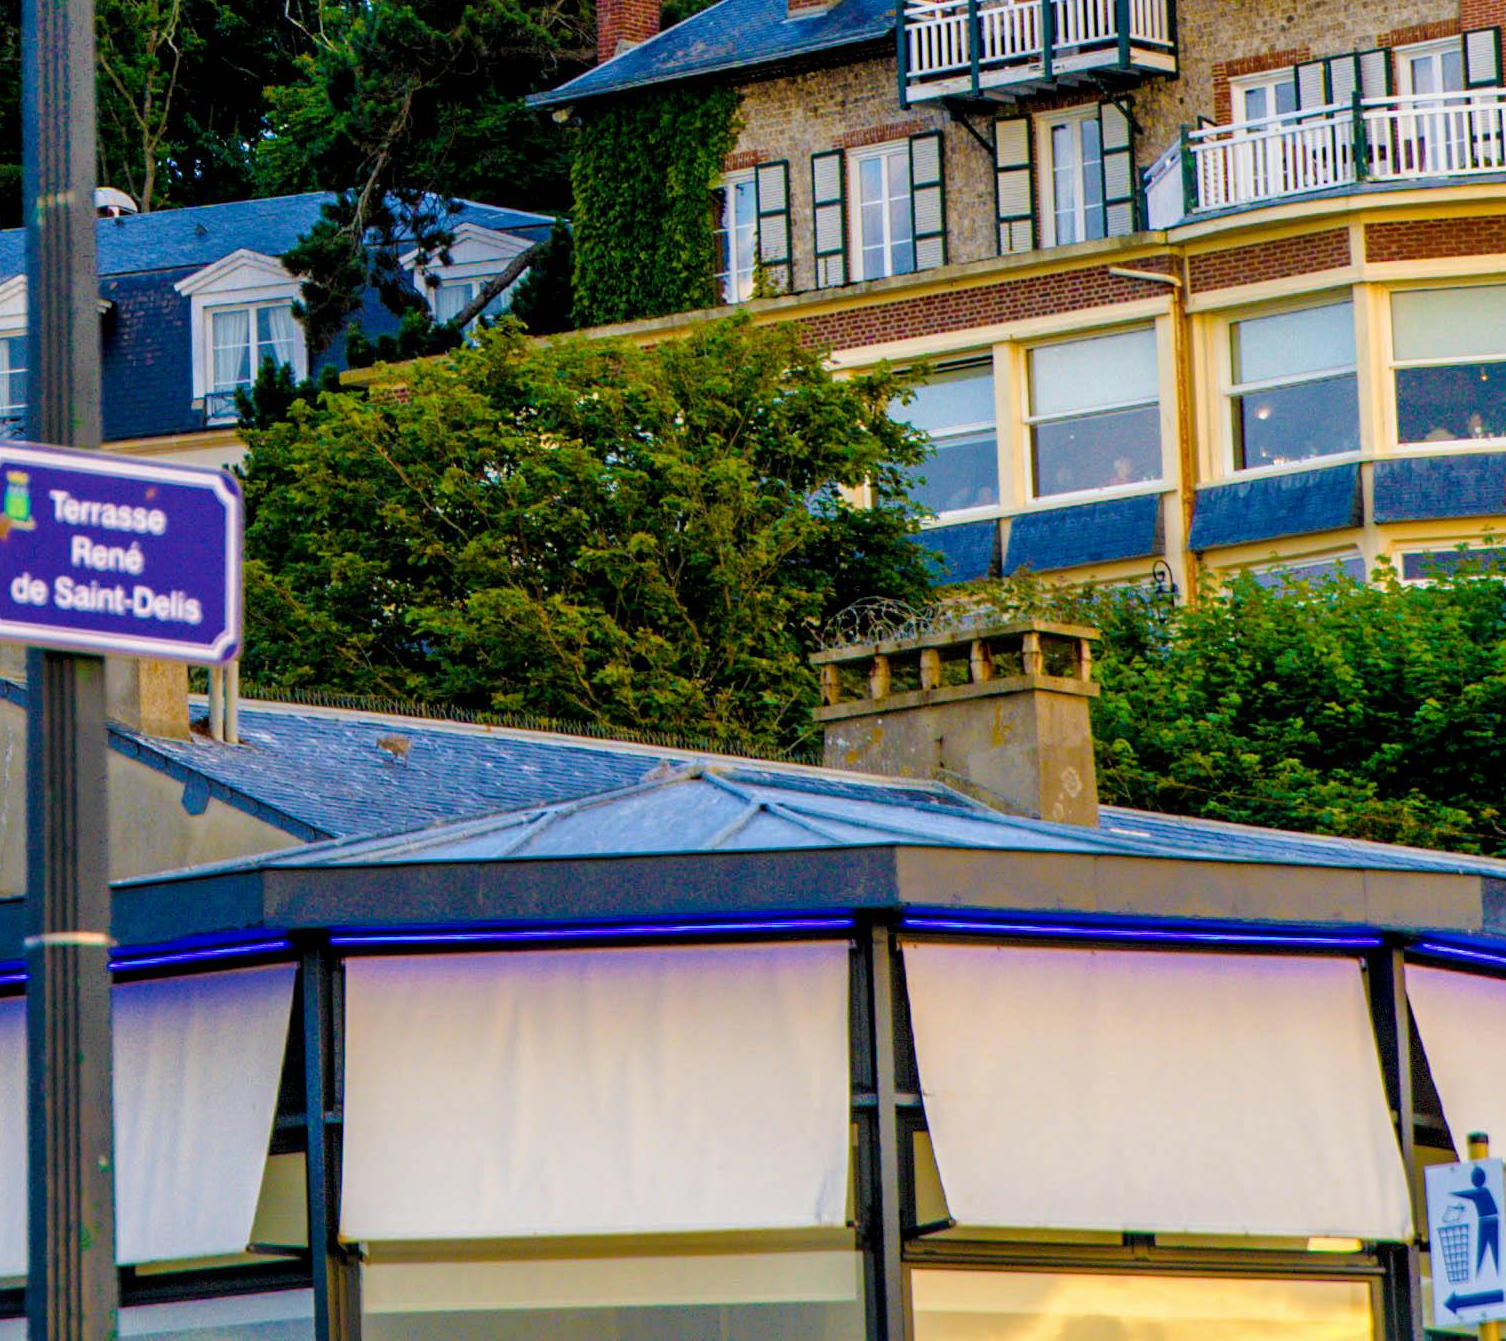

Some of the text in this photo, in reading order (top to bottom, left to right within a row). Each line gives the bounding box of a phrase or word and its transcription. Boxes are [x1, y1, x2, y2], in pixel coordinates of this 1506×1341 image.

[50, 490, 167, 535] Terrasse
[71, 536, 144, 574] René
[10, 573, 202, 624] de Saint-Delis
